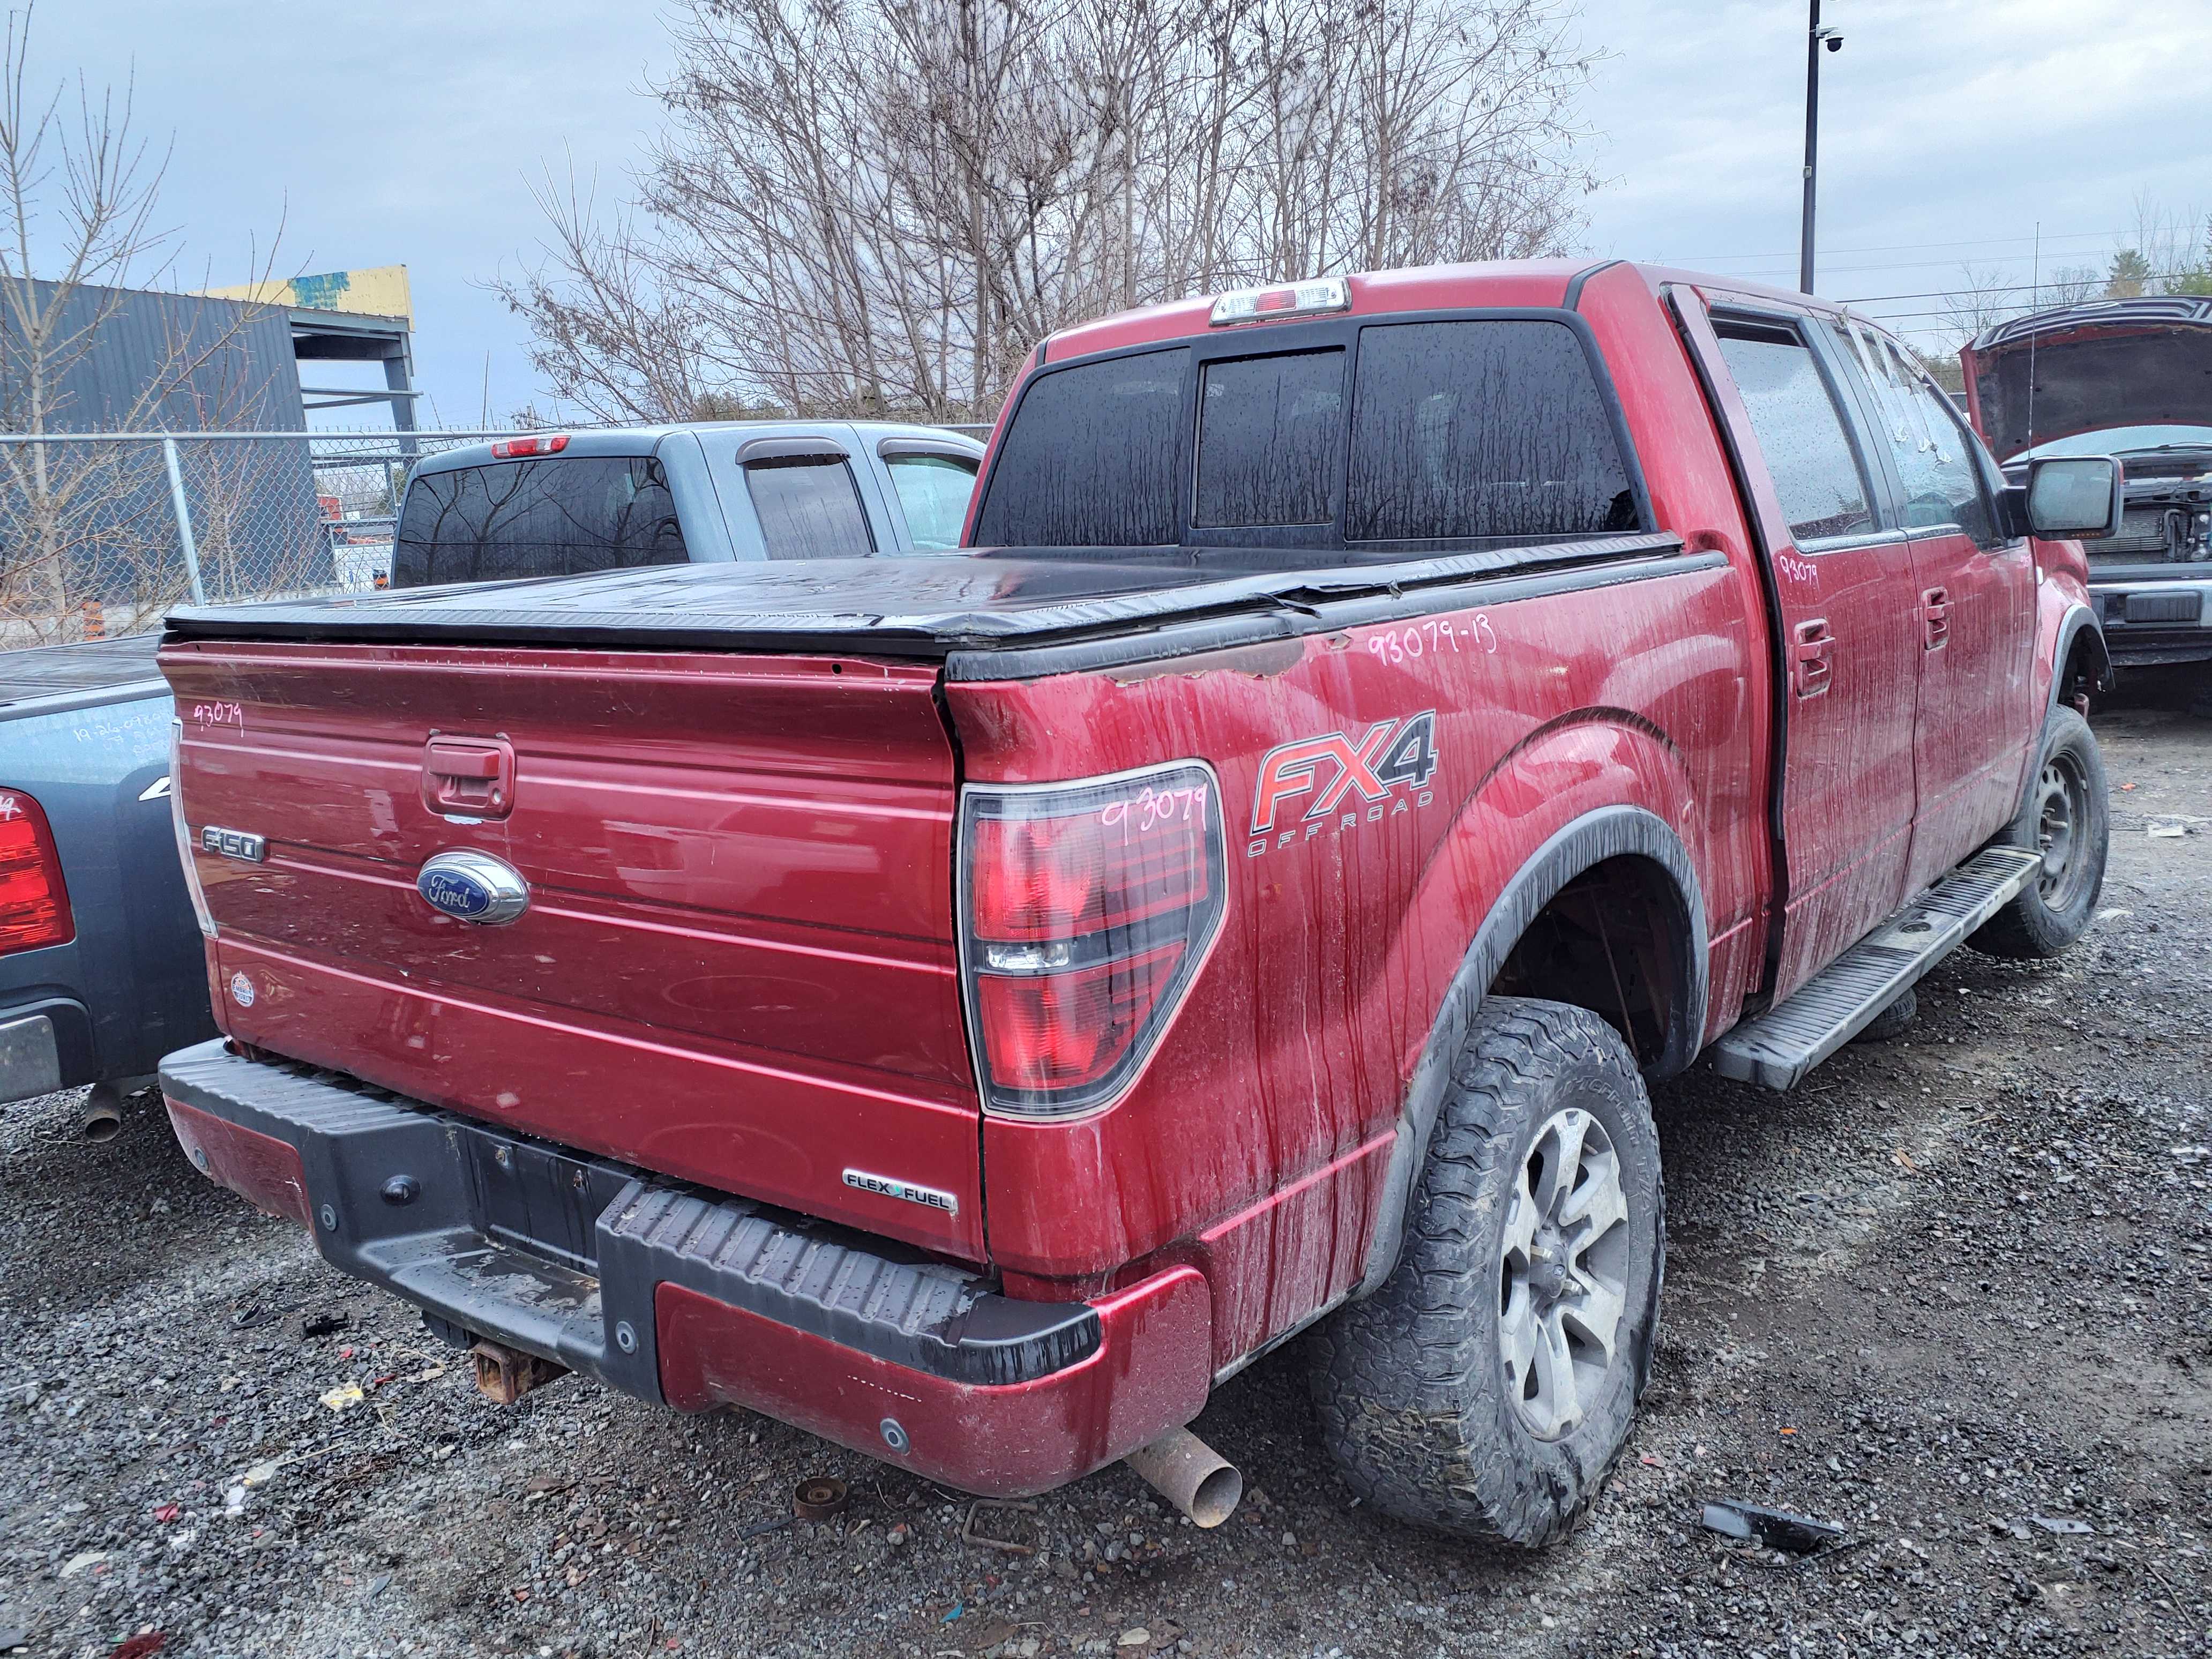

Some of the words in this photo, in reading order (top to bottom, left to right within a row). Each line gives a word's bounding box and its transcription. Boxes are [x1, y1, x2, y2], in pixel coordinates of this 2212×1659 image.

[1780, 555, 1820, 591] 93079
[193, 701, 244, 738] 93079
[1250, 708, 1439, 836] FX4
[1101, 782, 1208, 846] 93079
[429, 875, 470, 909] Ford
[847, 1174, 891, 1194] FLEX
[905, 1187, 949, 1208] FUEL
